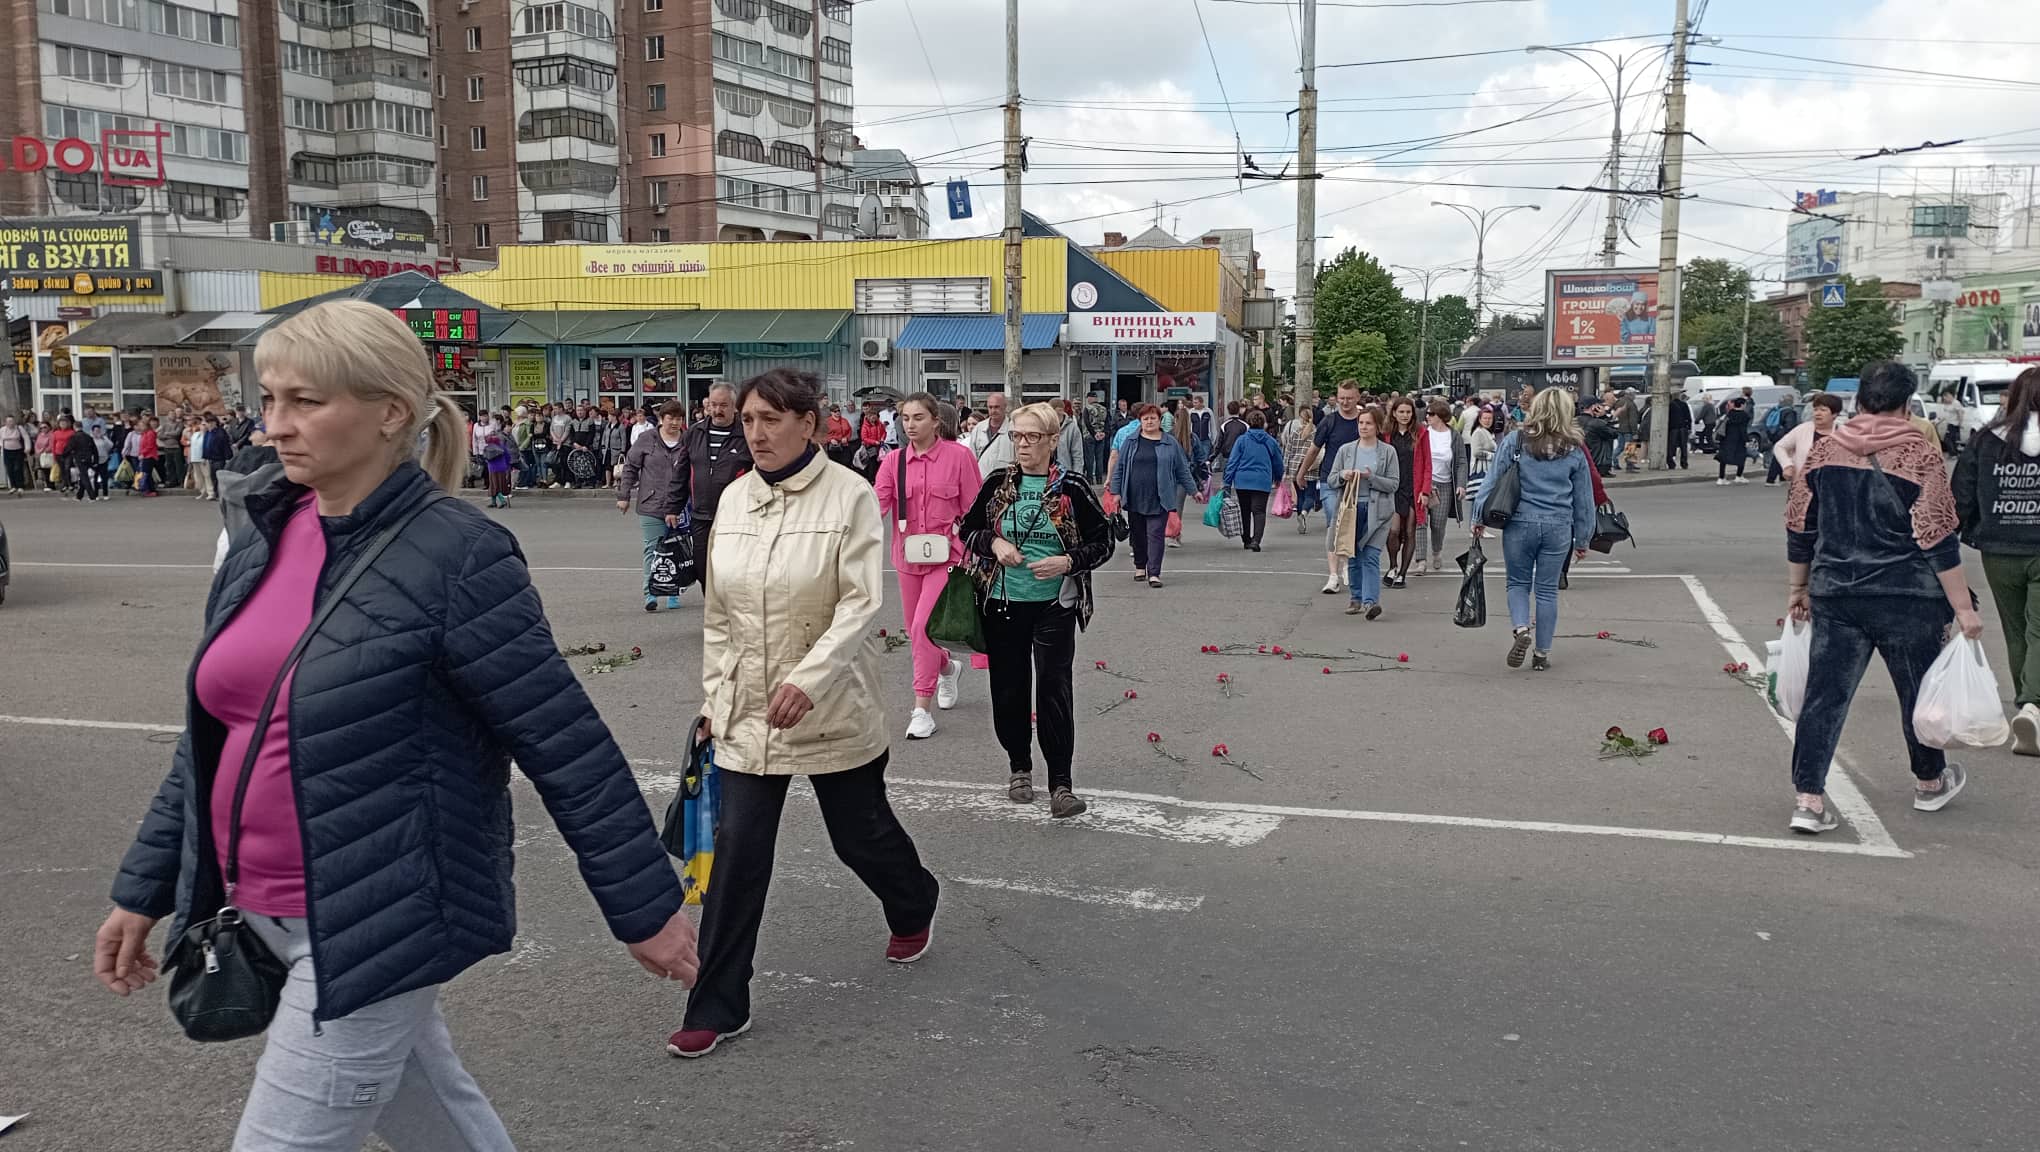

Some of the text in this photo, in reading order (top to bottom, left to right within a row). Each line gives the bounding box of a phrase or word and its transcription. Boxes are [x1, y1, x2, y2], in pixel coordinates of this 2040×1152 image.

[113, 149, 151, 168] UA
[42, 230, 57, 242] ТА
[60, 225, 128, 243] СТОКОВИЙ
[27, 252, 39, 269] &
[44, 243, 130, 270] ВЗУТТЯ
[585, 259, 705, 274] «Все по смішній ціні»
[97, 275, 122, 291] щойно
[1092, 315, 1196, 329] ВІННИЦЬКА
[1569, 316, 1596, 335] 1%
[1114, 328, 1174, 340] ПТИЦЯ
